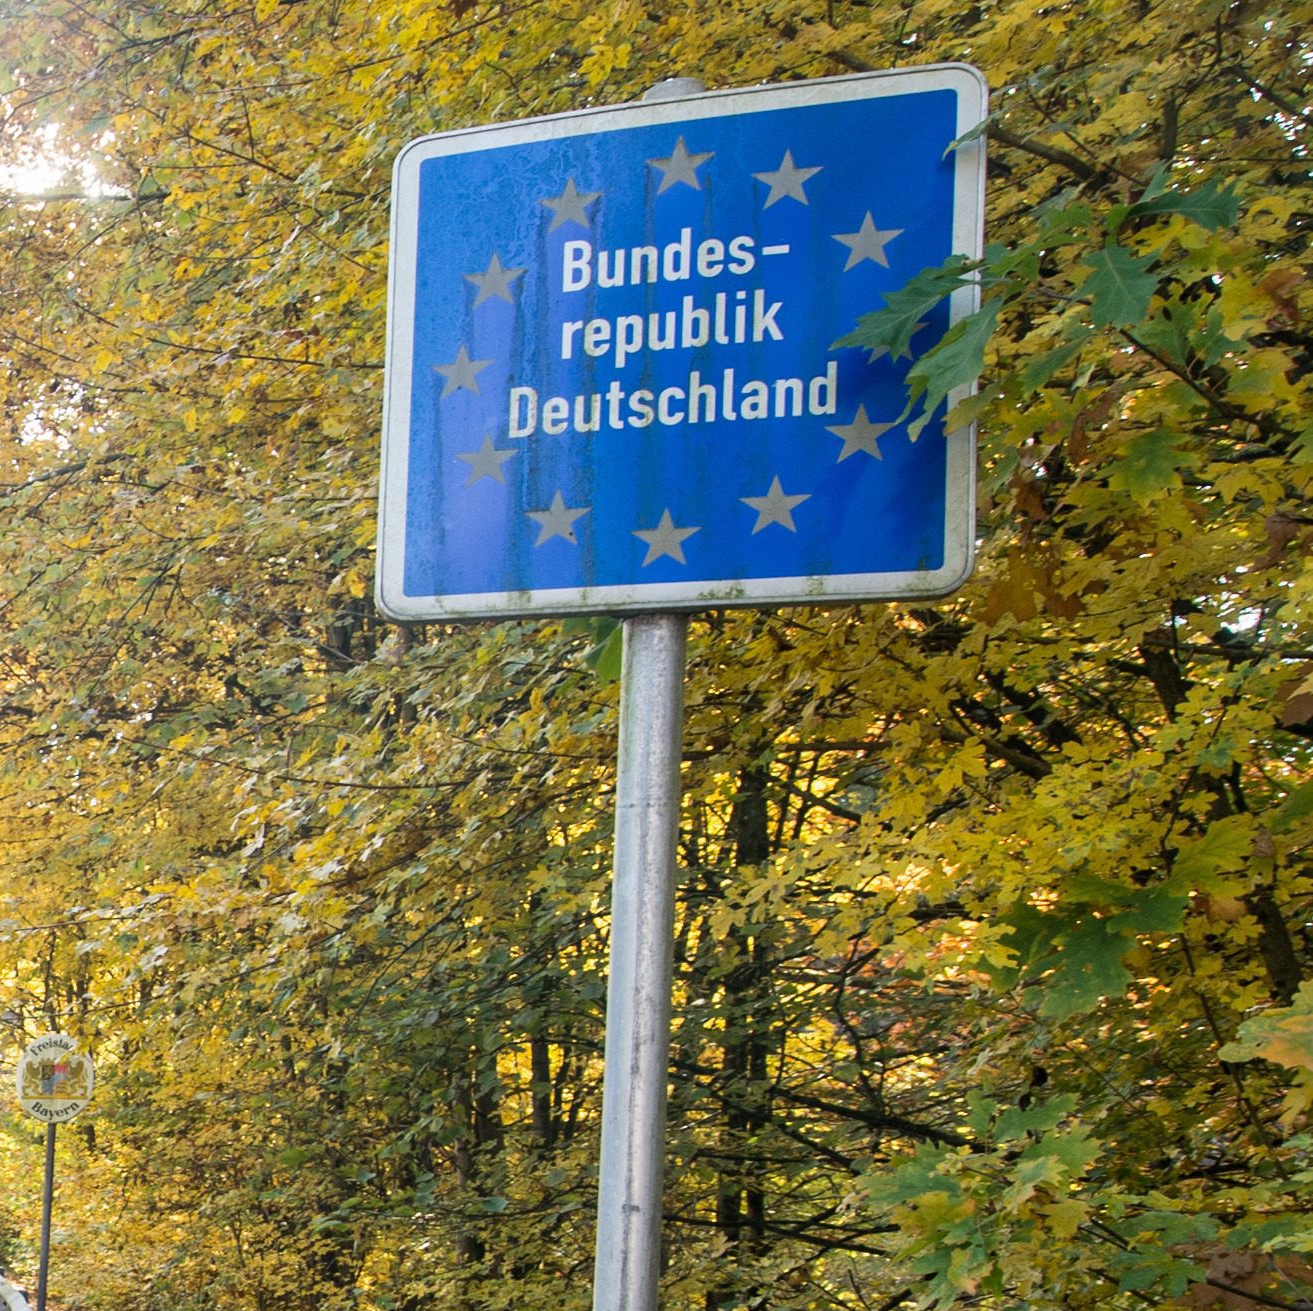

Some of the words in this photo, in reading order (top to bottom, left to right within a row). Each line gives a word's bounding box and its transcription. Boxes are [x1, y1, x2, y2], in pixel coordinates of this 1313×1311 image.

[561, 227, 790, 292] Bundes-
[560, 289, 784, 367] republik
[508, 361, 838, 439] Deutschland
[31, 1101, 80, 1120] Bayern
